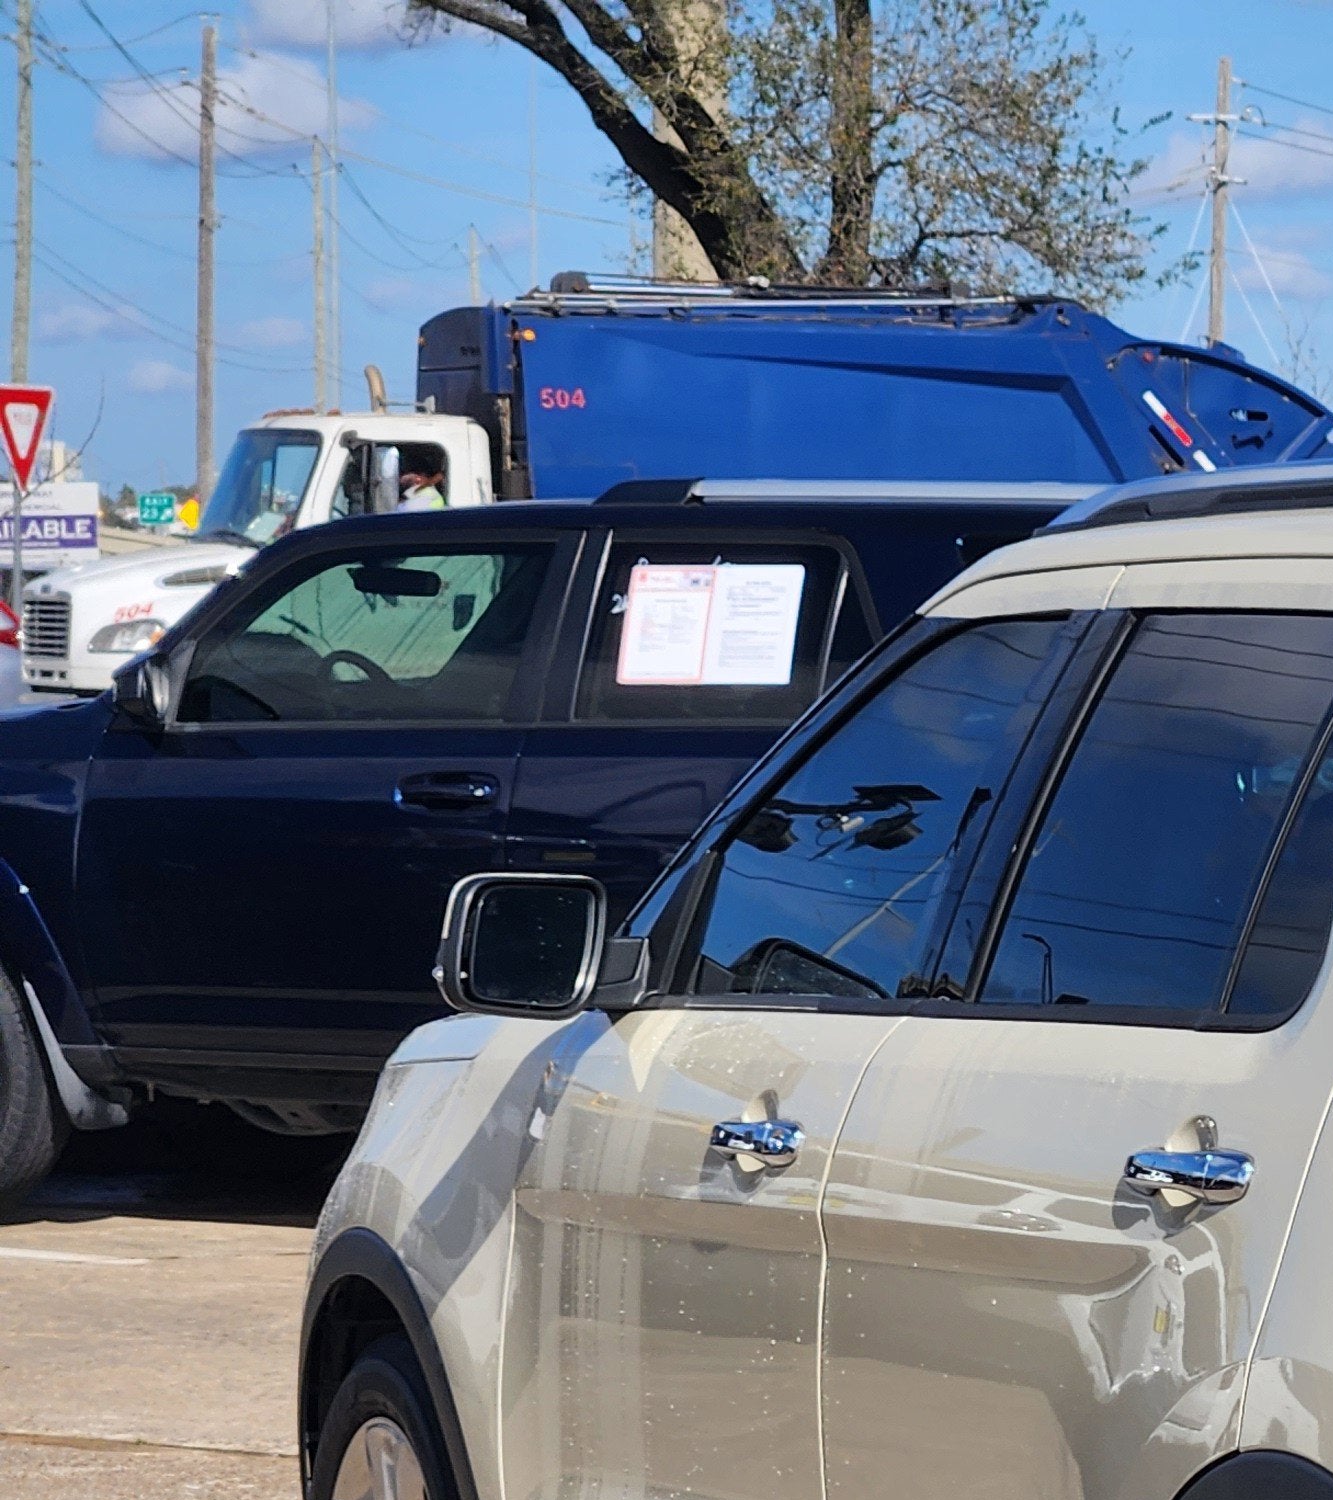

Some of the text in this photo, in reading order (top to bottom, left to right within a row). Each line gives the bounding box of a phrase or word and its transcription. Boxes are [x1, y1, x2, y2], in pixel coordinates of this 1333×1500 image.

[540, 388, 586, 409] 504
[0, 519, 92, 540] IABLE
[114, 602, 154, 623] 504
